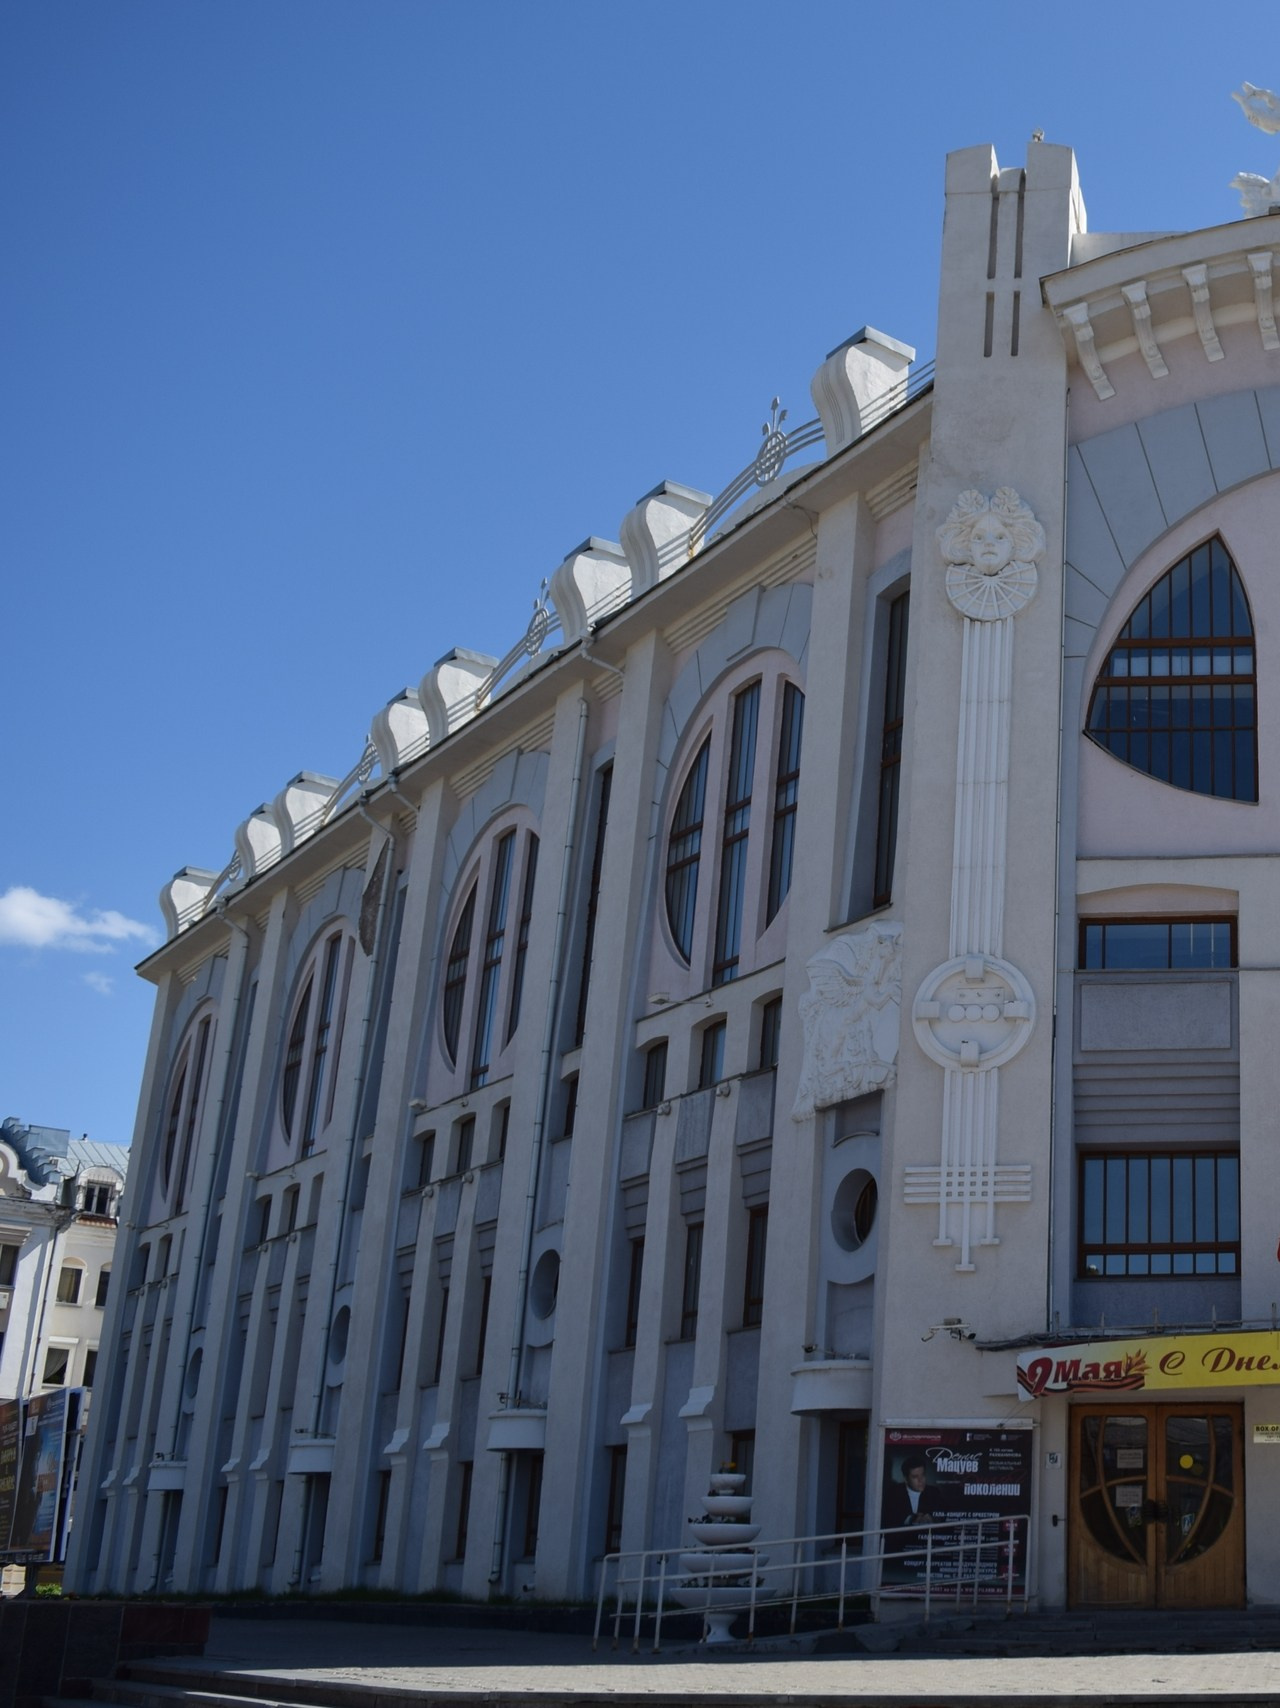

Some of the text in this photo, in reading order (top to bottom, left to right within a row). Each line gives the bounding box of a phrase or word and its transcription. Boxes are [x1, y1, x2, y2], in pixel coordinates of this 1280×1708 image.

[1053, 1356, 1124, 1384] Мая
[1159, 1351, 1186, 1376] С
[936, 1457, 979, 1475] Мацуев
